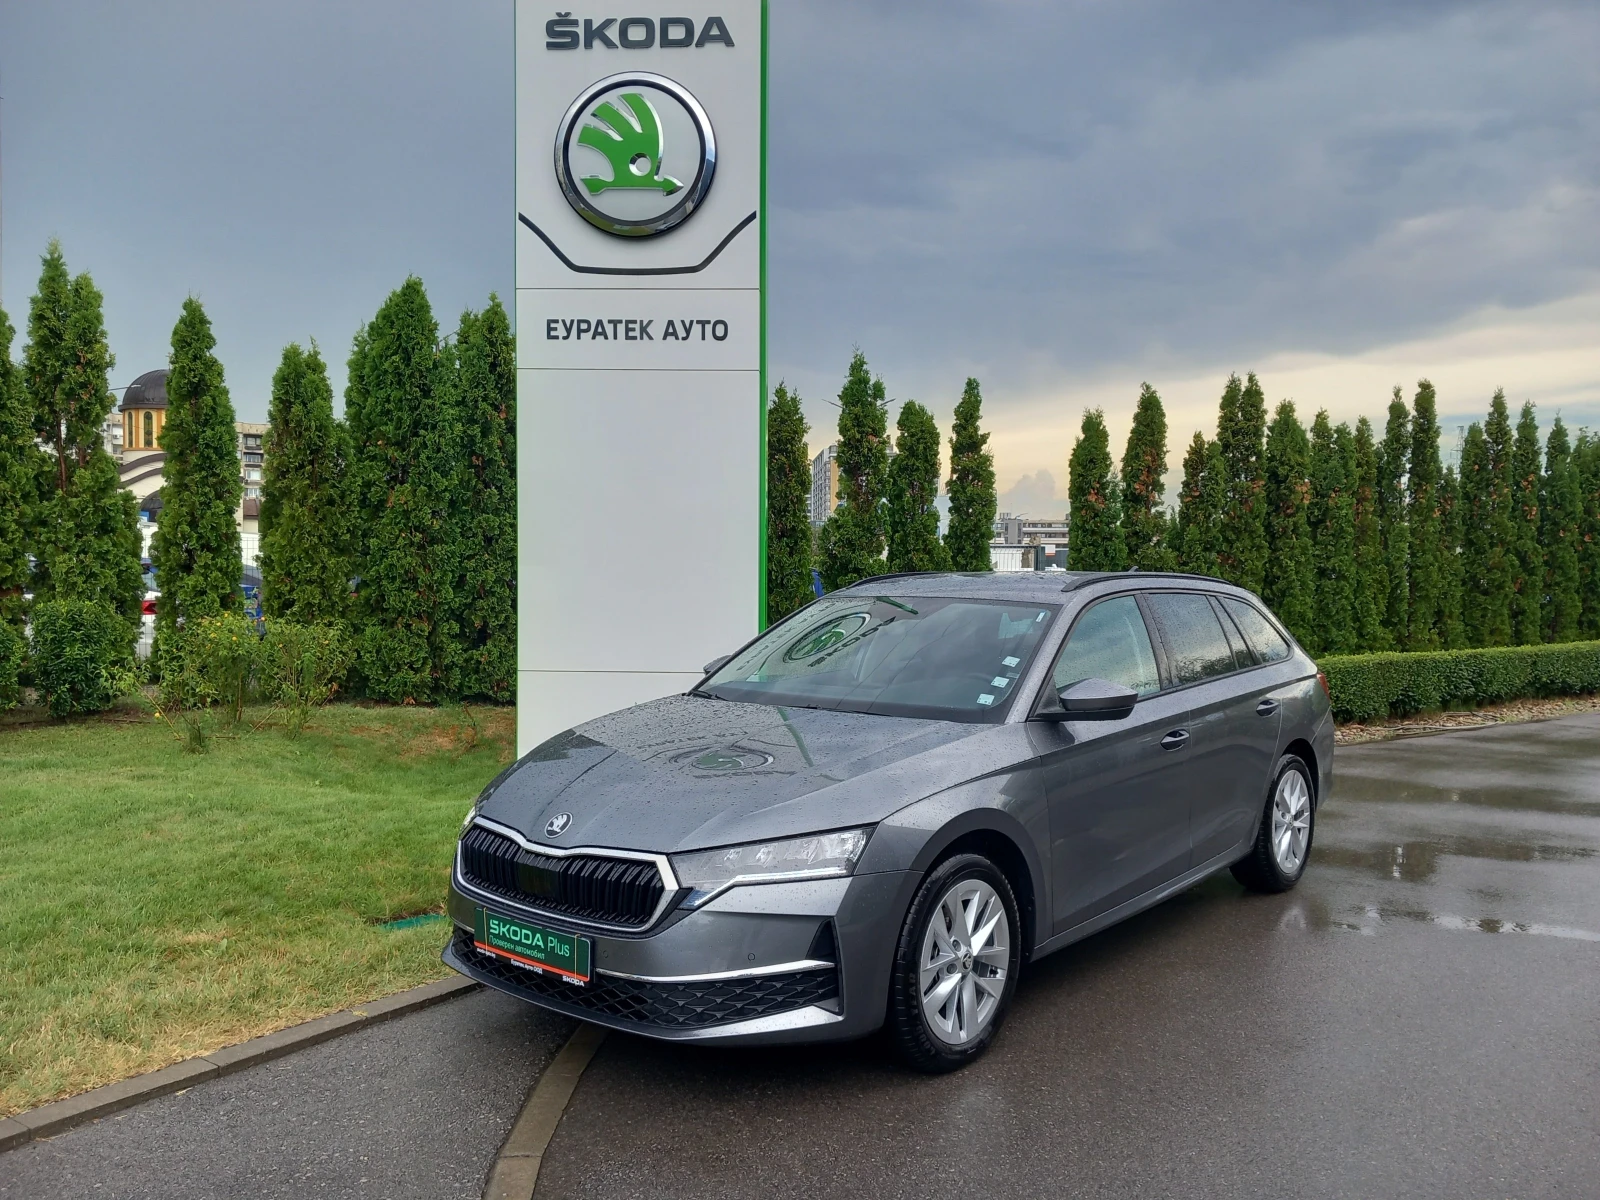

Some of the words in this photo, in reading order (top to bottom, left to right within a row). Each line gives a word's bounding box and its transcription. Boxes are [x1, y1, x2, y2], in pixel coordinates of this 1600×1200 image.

[545, 12, 735, 50] ŠKODA
[546, 319, 654, 340] ЕУРАТЕК
[662, 319, 728, 341] АУТО
[488, 935, 514, 951] Проверен
[515, 944, 545, 960] автомобил
[547, 936, 570, 957] Plus
